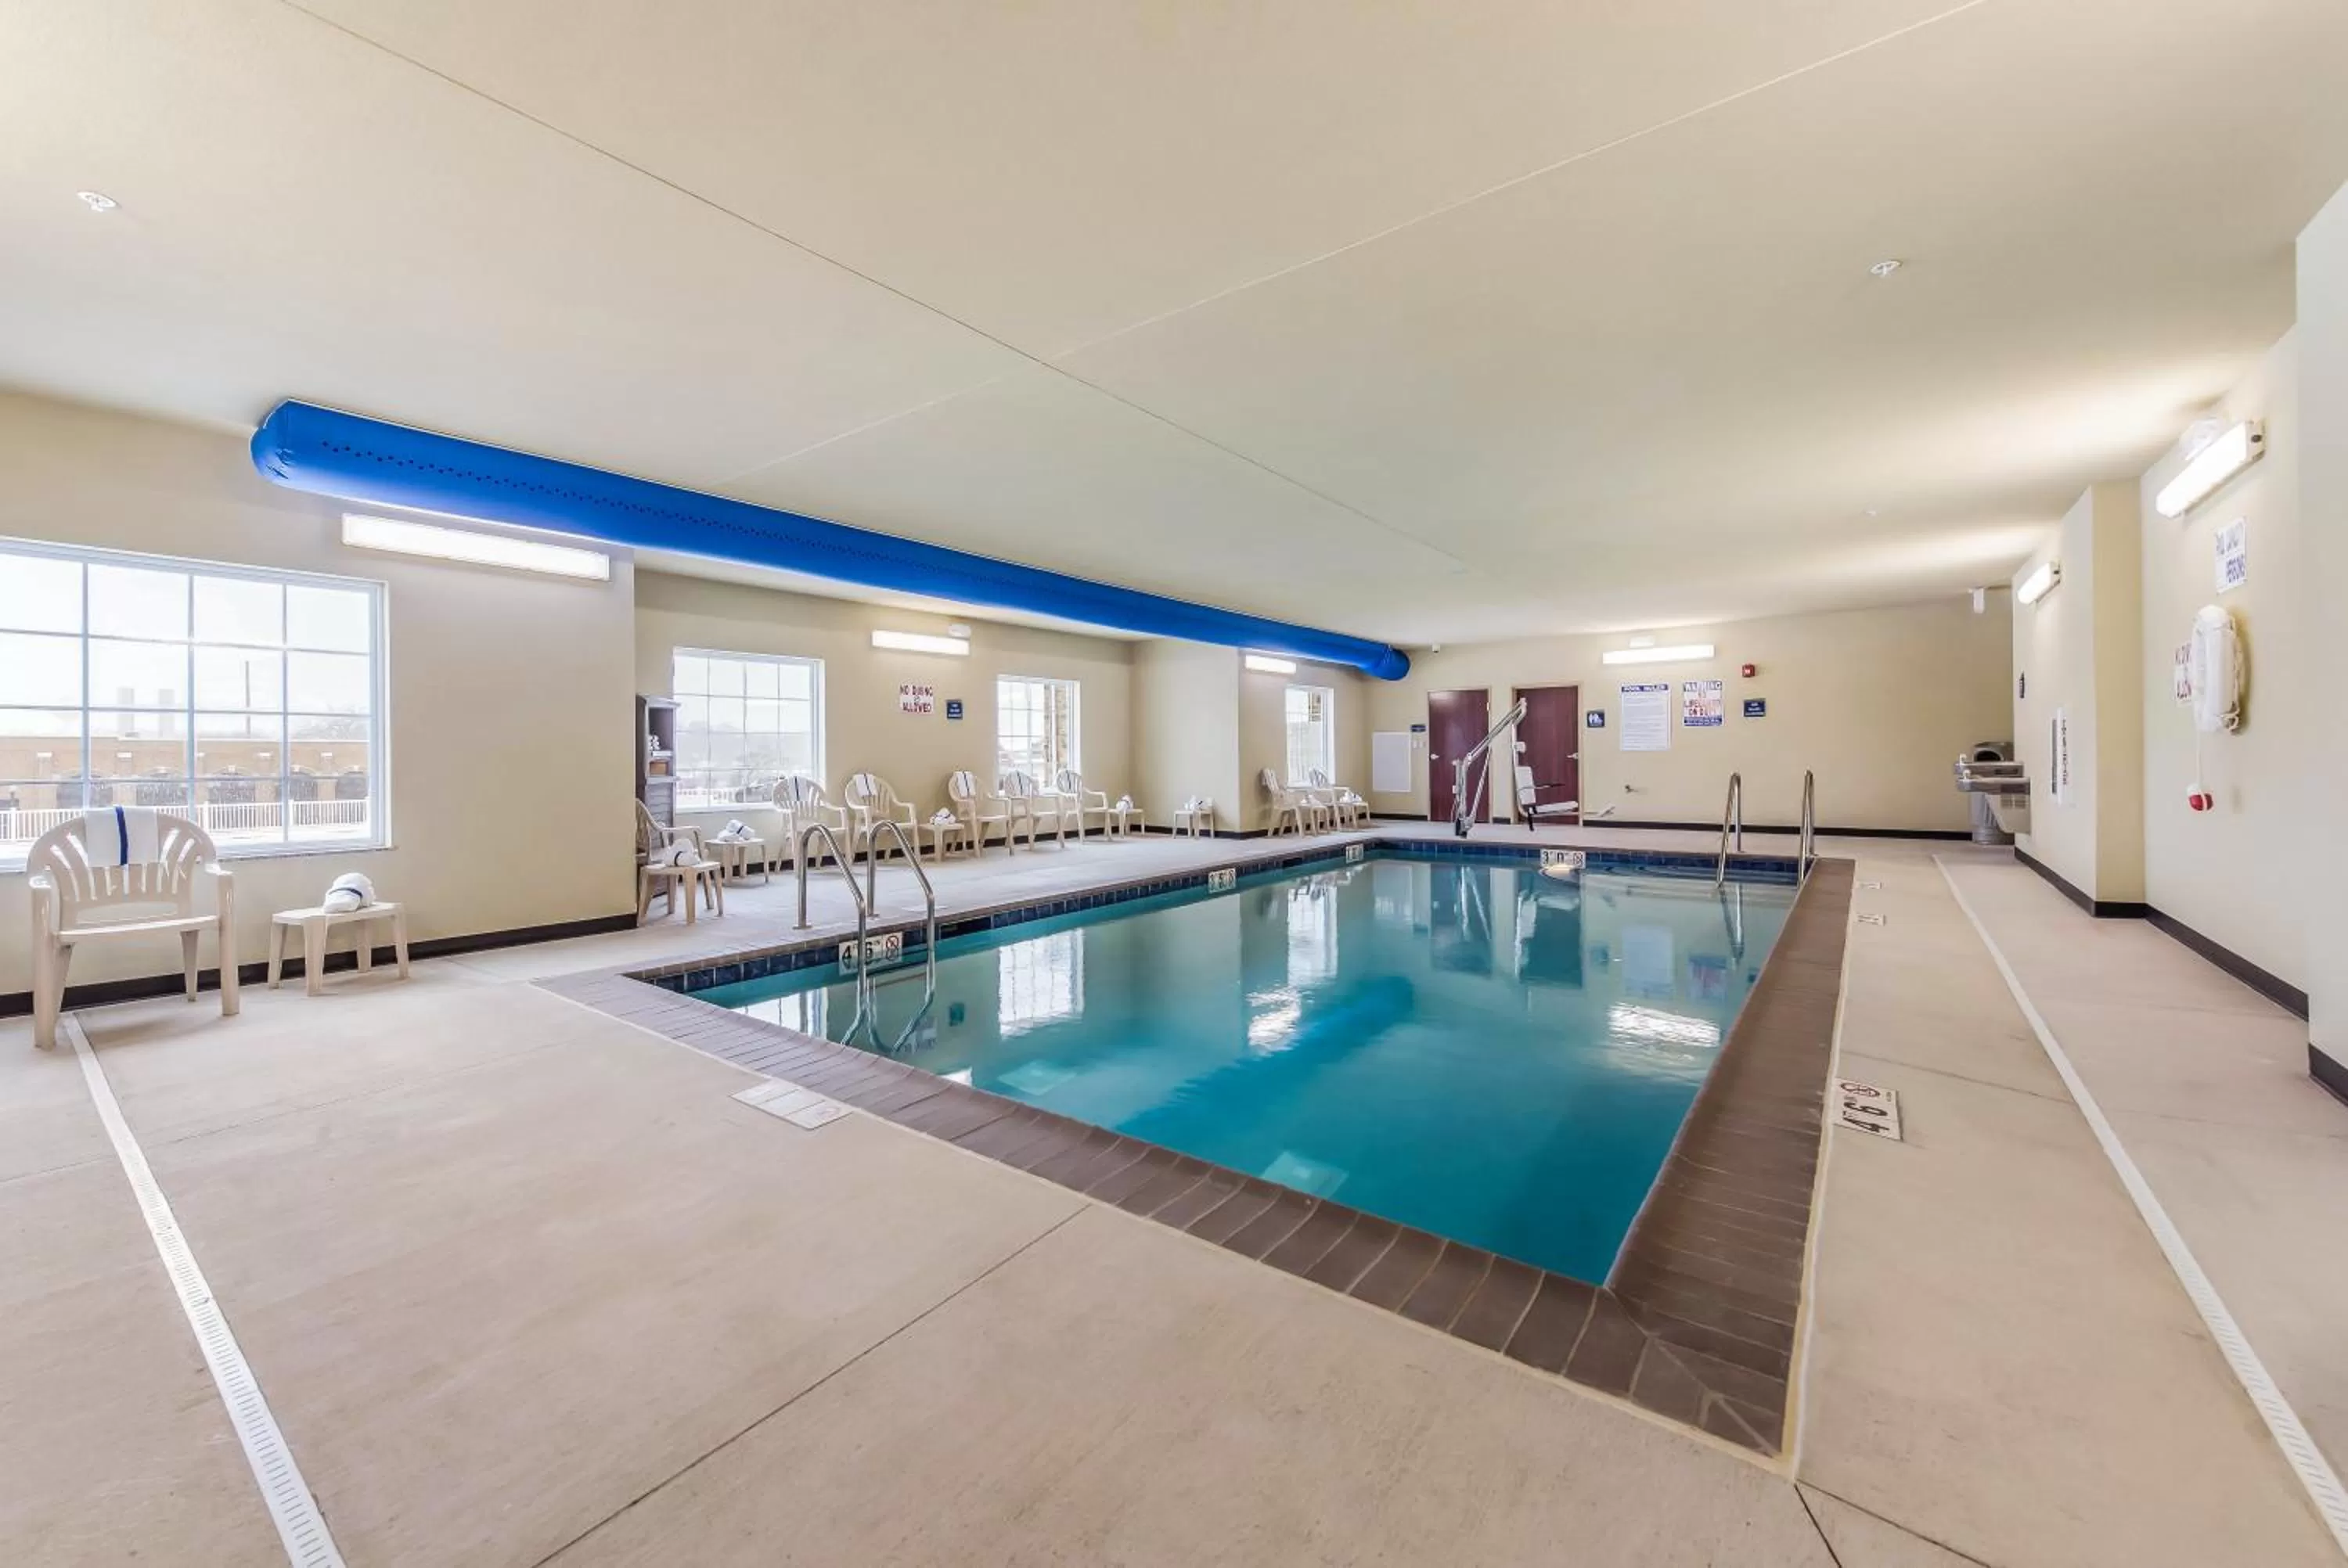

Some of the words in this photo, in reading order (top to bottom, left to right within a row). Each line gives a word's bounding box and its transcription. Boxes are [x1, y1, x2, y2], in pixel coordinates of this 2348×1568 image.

[899, 685, 909, 696] NO
[902, 702, 932, 713] ALLOWED
[842, 945, 852, 959] 4
[1842, 1116, 1889, 1133] 4
